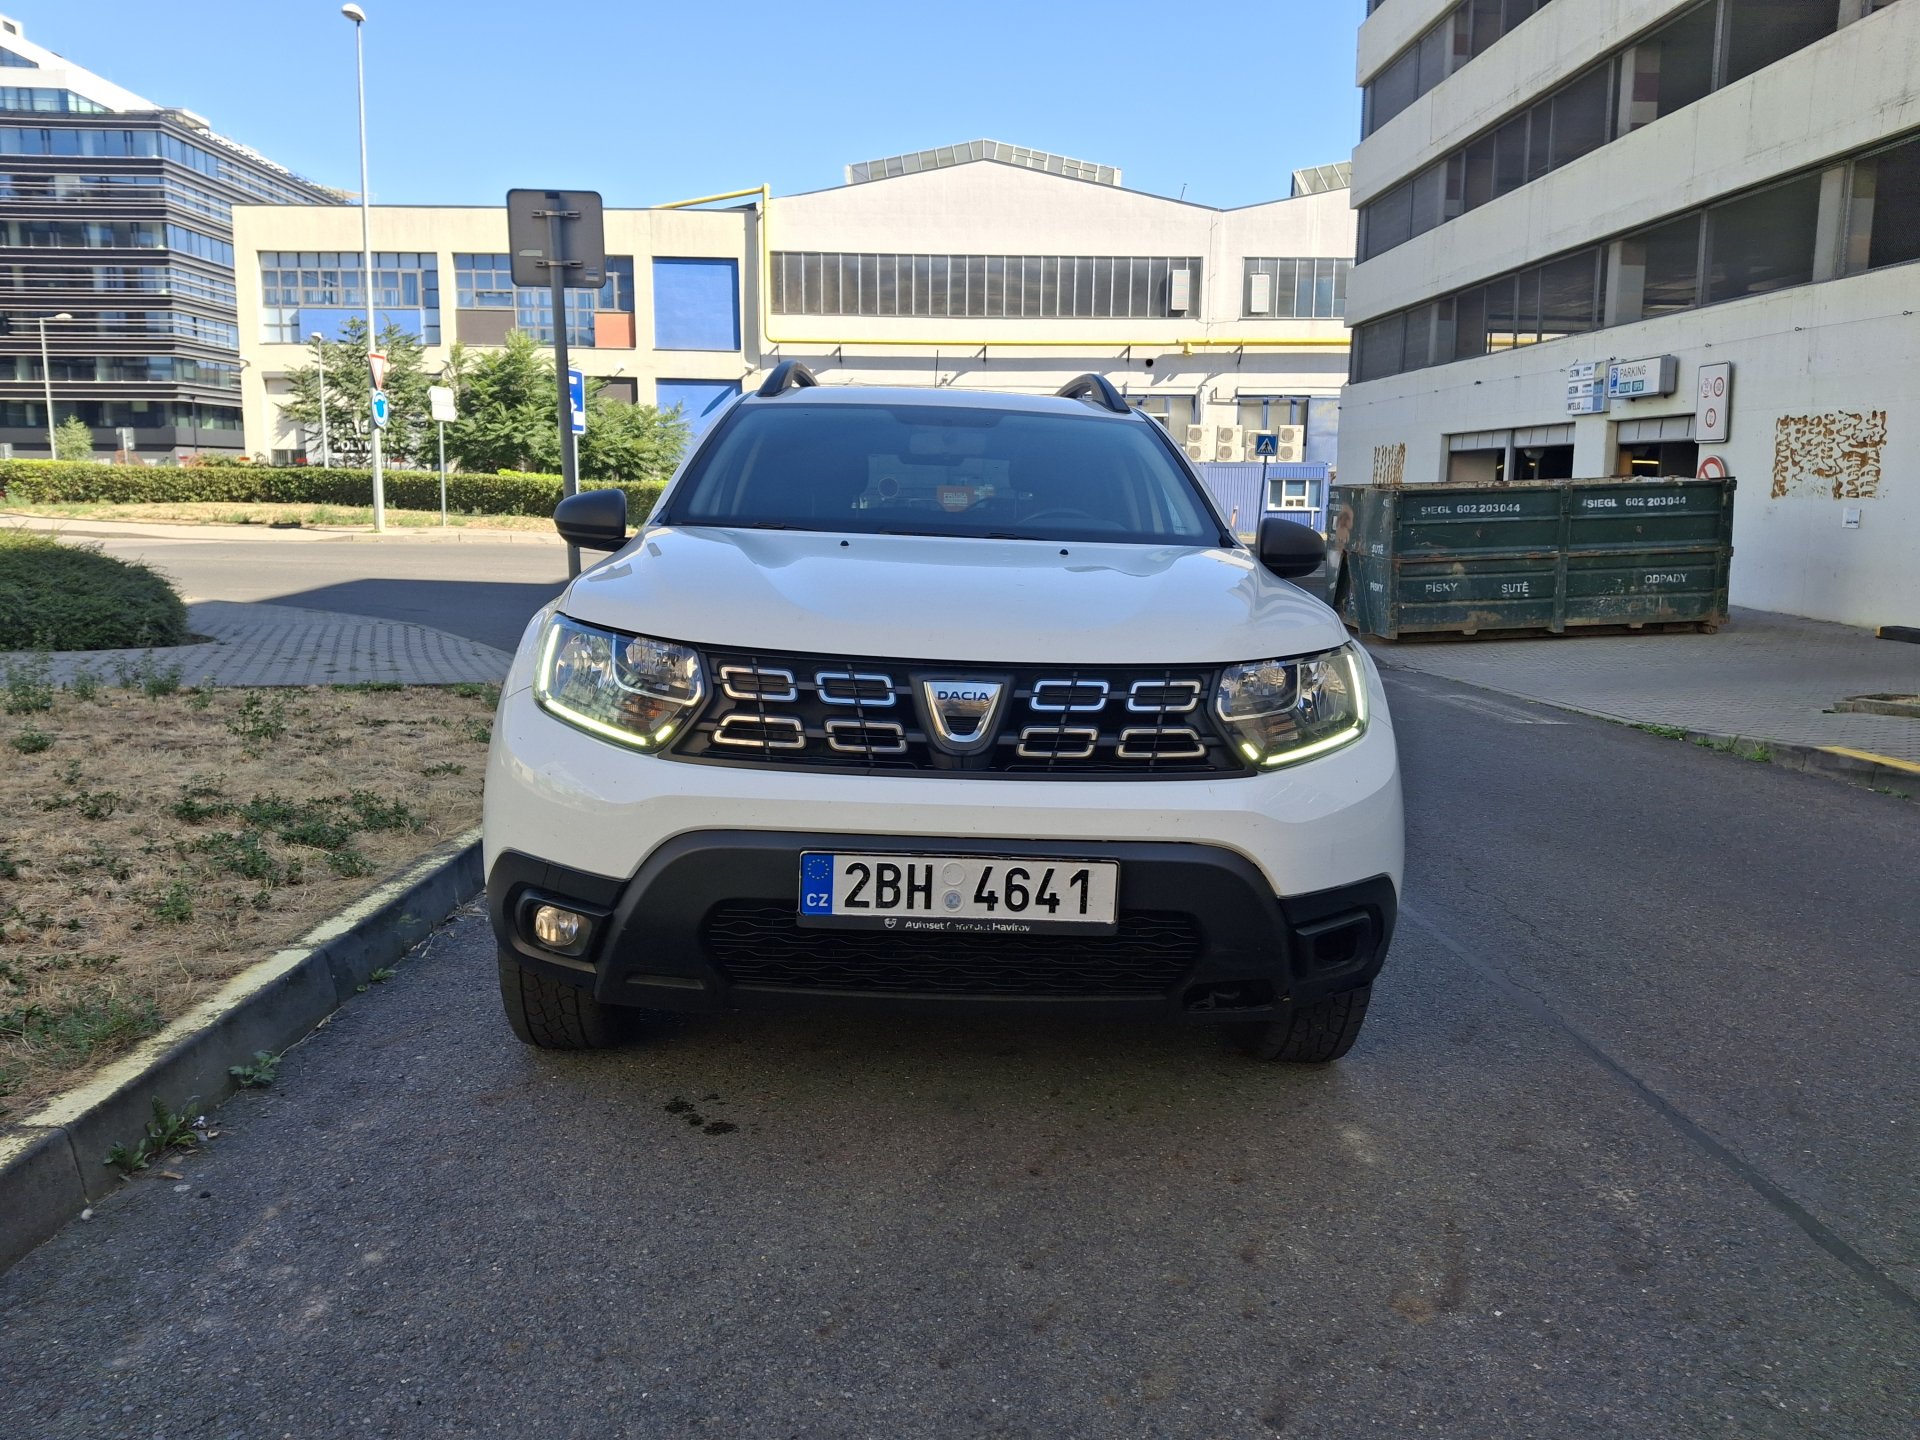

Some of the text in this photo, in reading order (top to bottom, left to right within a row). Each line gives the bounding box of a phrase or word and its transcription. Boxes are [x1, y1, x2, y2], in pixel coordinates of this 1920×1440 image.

[1619, 365, 1647, 378] PARKING
[1587, 498, 1618, 508] SIEGL
[1625, 497, 1645, 506] 602
[1420, 506, 1451, 515] SIEGL
[1456, 504, 1477, 513] 602
[1644, 573, 1687, 583] ODPADY
[1425, 582, 1458, 592] PÍSKY
[937, 690, 990, 702] DACIA
[844, 862, 1090, 914] 2BH 4641
[806, 893, 829, 907] CZ
